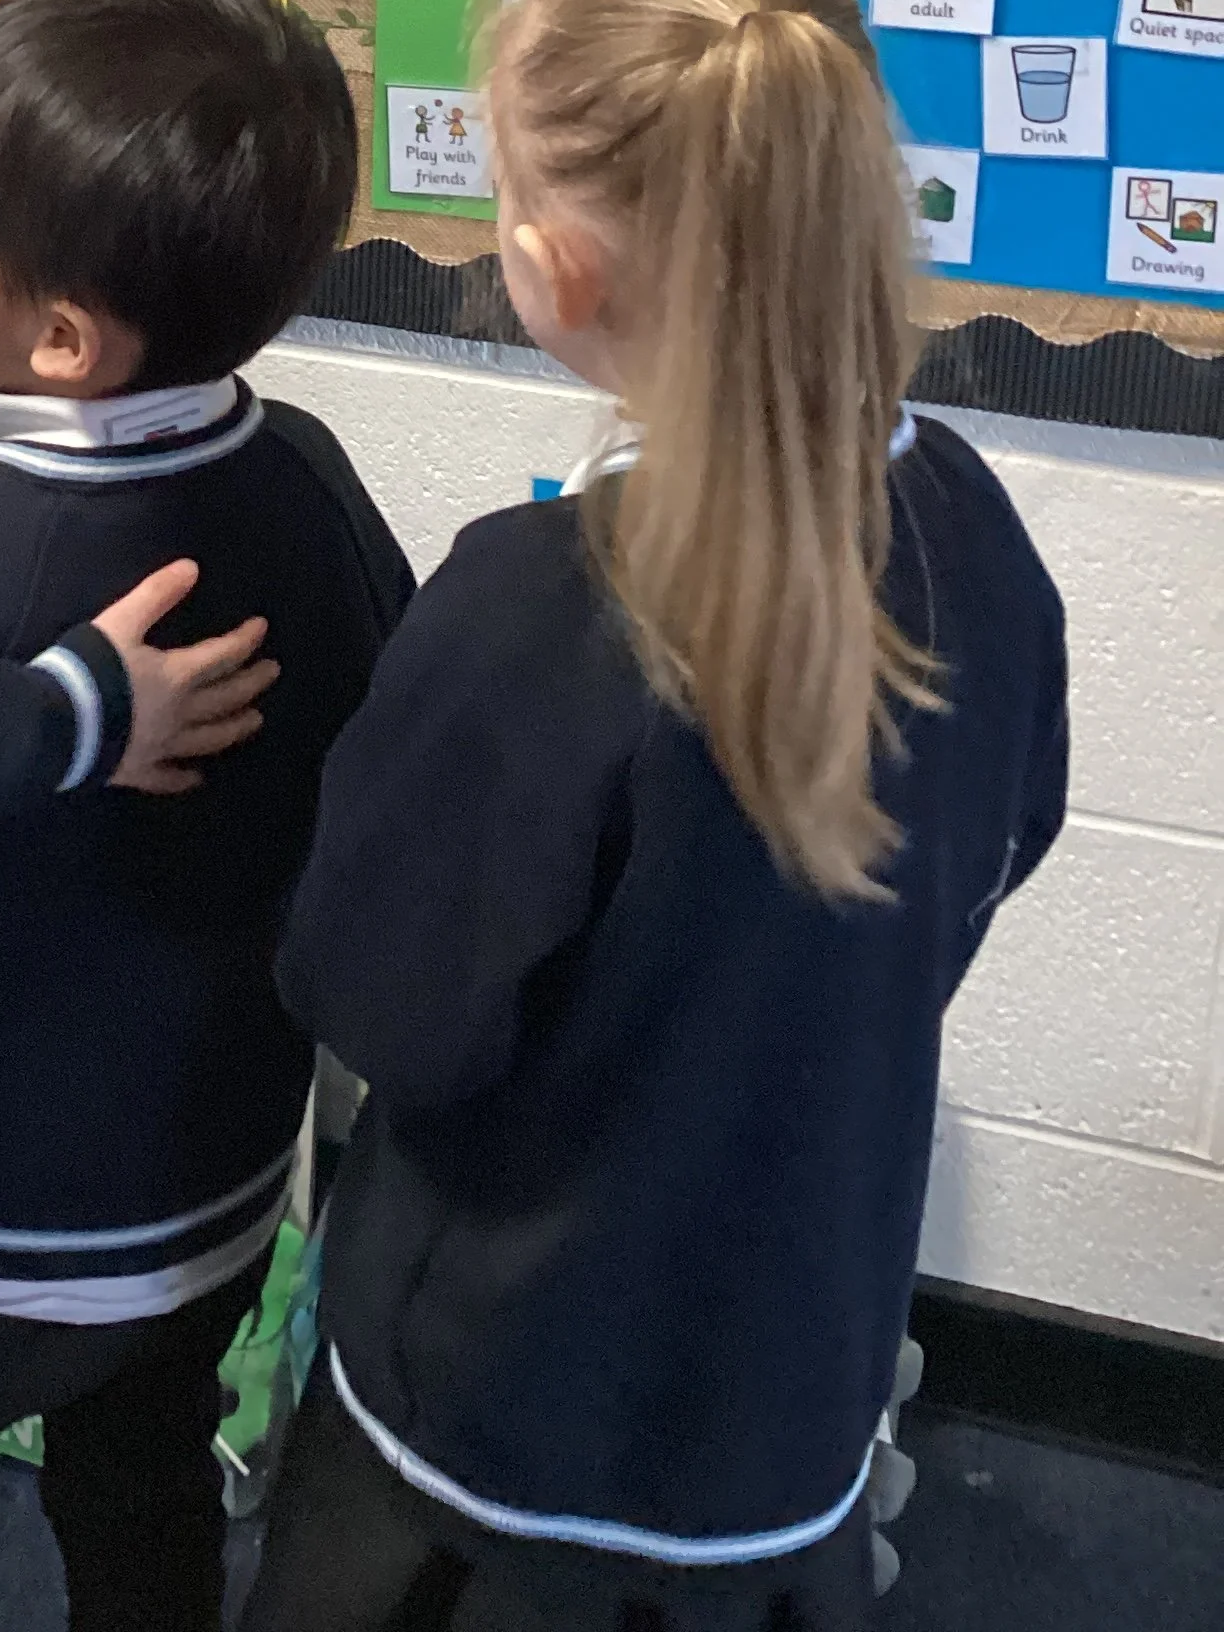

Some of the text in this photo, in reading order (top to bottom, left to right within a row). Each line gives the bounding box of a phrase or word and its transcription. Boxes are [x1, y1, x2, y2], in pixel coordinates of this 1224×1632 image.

[909, 1, 956, 20] adult
[1129, 17, 1177, 39] Quiet
[1020, 127, 1068, 145] Drink
[405, 145, 476, 166] Play with
[413, 169, 466, 188] friends
[1130, 256, 1205, 282] Drawing
